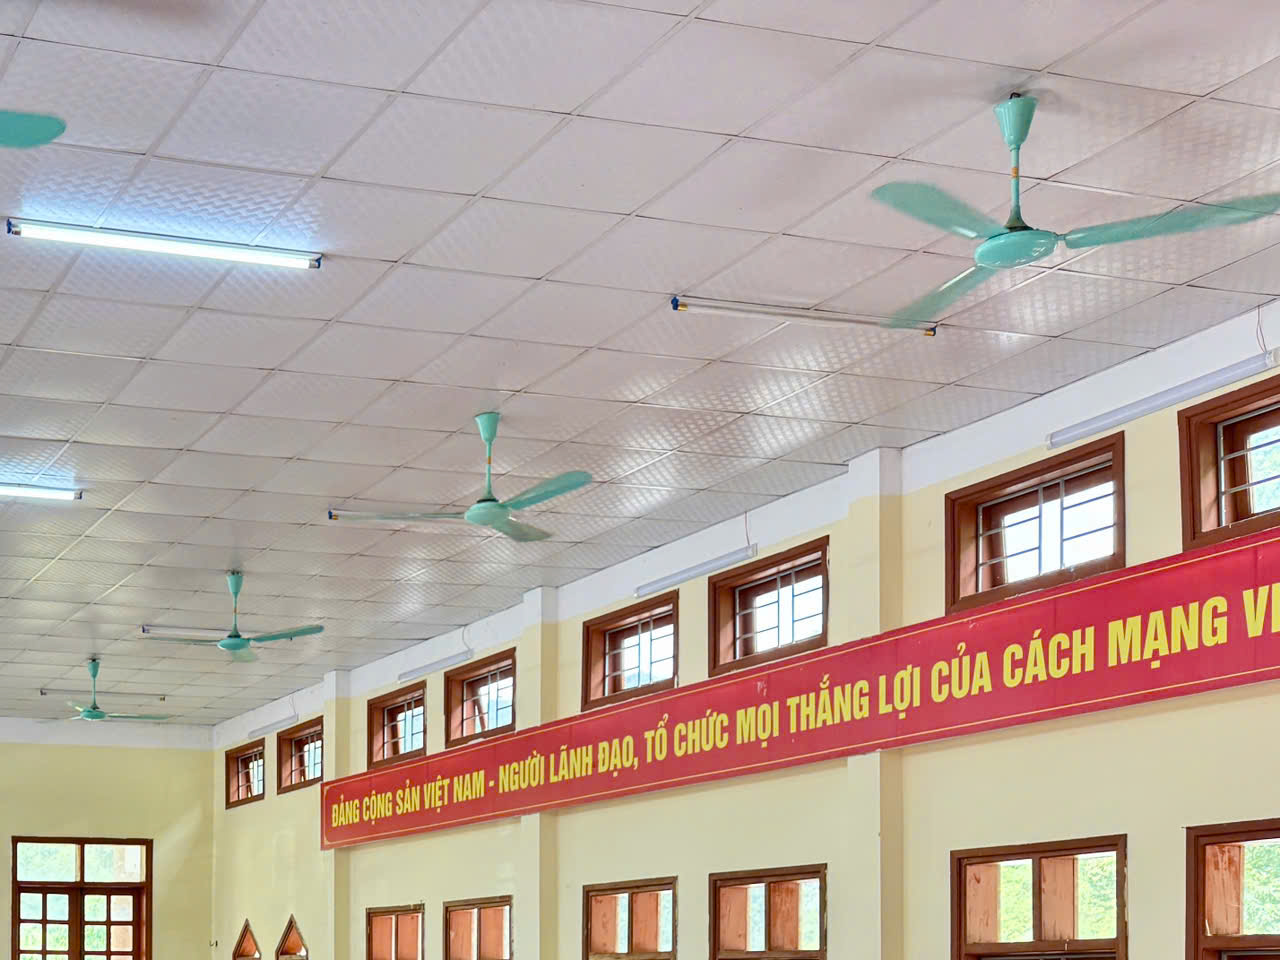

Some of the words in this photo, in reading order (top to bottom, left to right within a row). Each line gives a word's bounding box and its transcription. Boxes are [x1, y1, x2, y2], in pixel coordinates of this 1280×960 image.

[331, 794, 360, 828] ĐẢNG
[362, 790, 392, 825] CỘNG
[396, 779, 420, 816] SẢN
[423, 775, 450, 813] VIỆT
[453, 770, 485, 804] NAM
[498, 750, 545, 793] NGƯỜI
[549, 744, 593, 783] LÃNH
[597, 735, 639, 777] ĐẠO,
[644, 713, 669, 763] TỔ
[674, 709, 729, 757] CHỨC
[736, 700, 780, 748] MỌI
[786, 674, 870, 734] THẮNG
[878, 663, 921, 719] LỢI
[930, 641, 993, 703] CỦA
[1002, 628, 1095, 688] CÁCH
[1107, 594, 1228, 669] MẠNG
